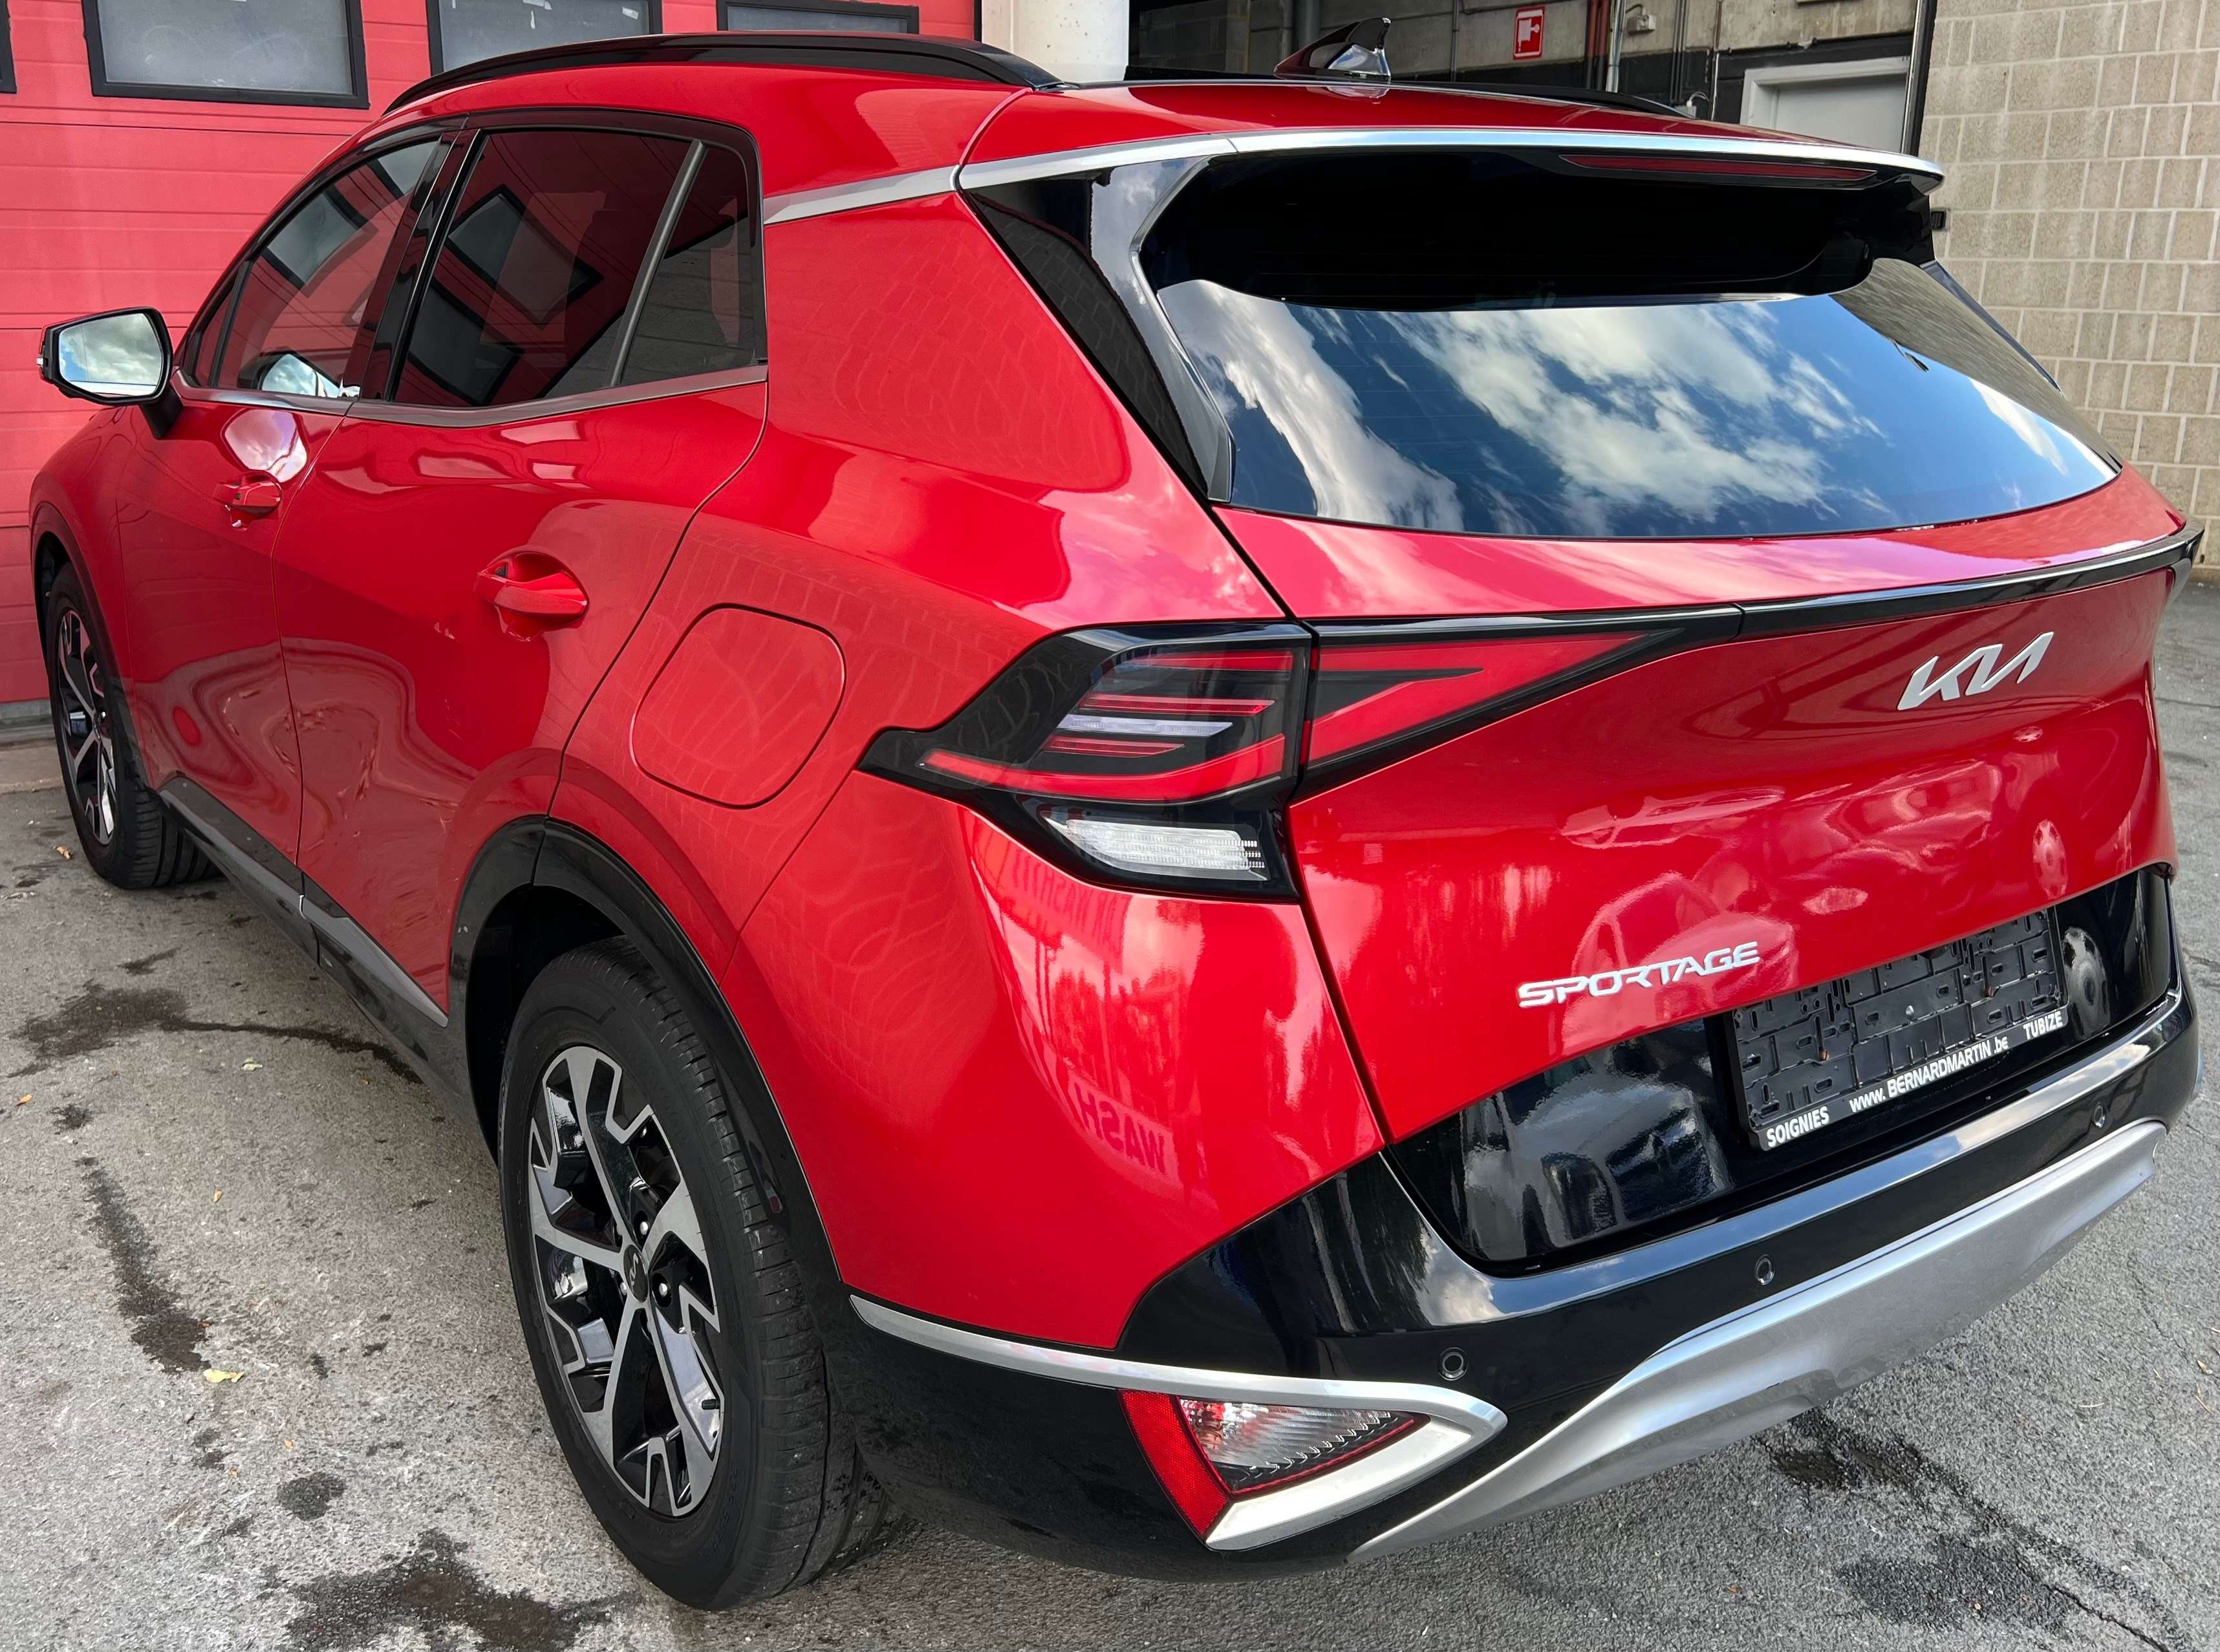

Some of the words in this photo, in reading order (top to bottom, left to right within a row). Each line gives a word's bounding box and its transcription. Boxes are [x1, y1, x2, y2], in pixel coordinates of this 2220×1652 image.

[1897, 631, 2054, 711] KIA
[1518, 941, 1760, 1007] SPORTAGE
[1766, 1106, 1830, 1148] SOIGNIES
[1887, 1040, 1992, 1096] BERNARDMARTIN
[2023, 1011, 2064, 1040] TUBIZE
